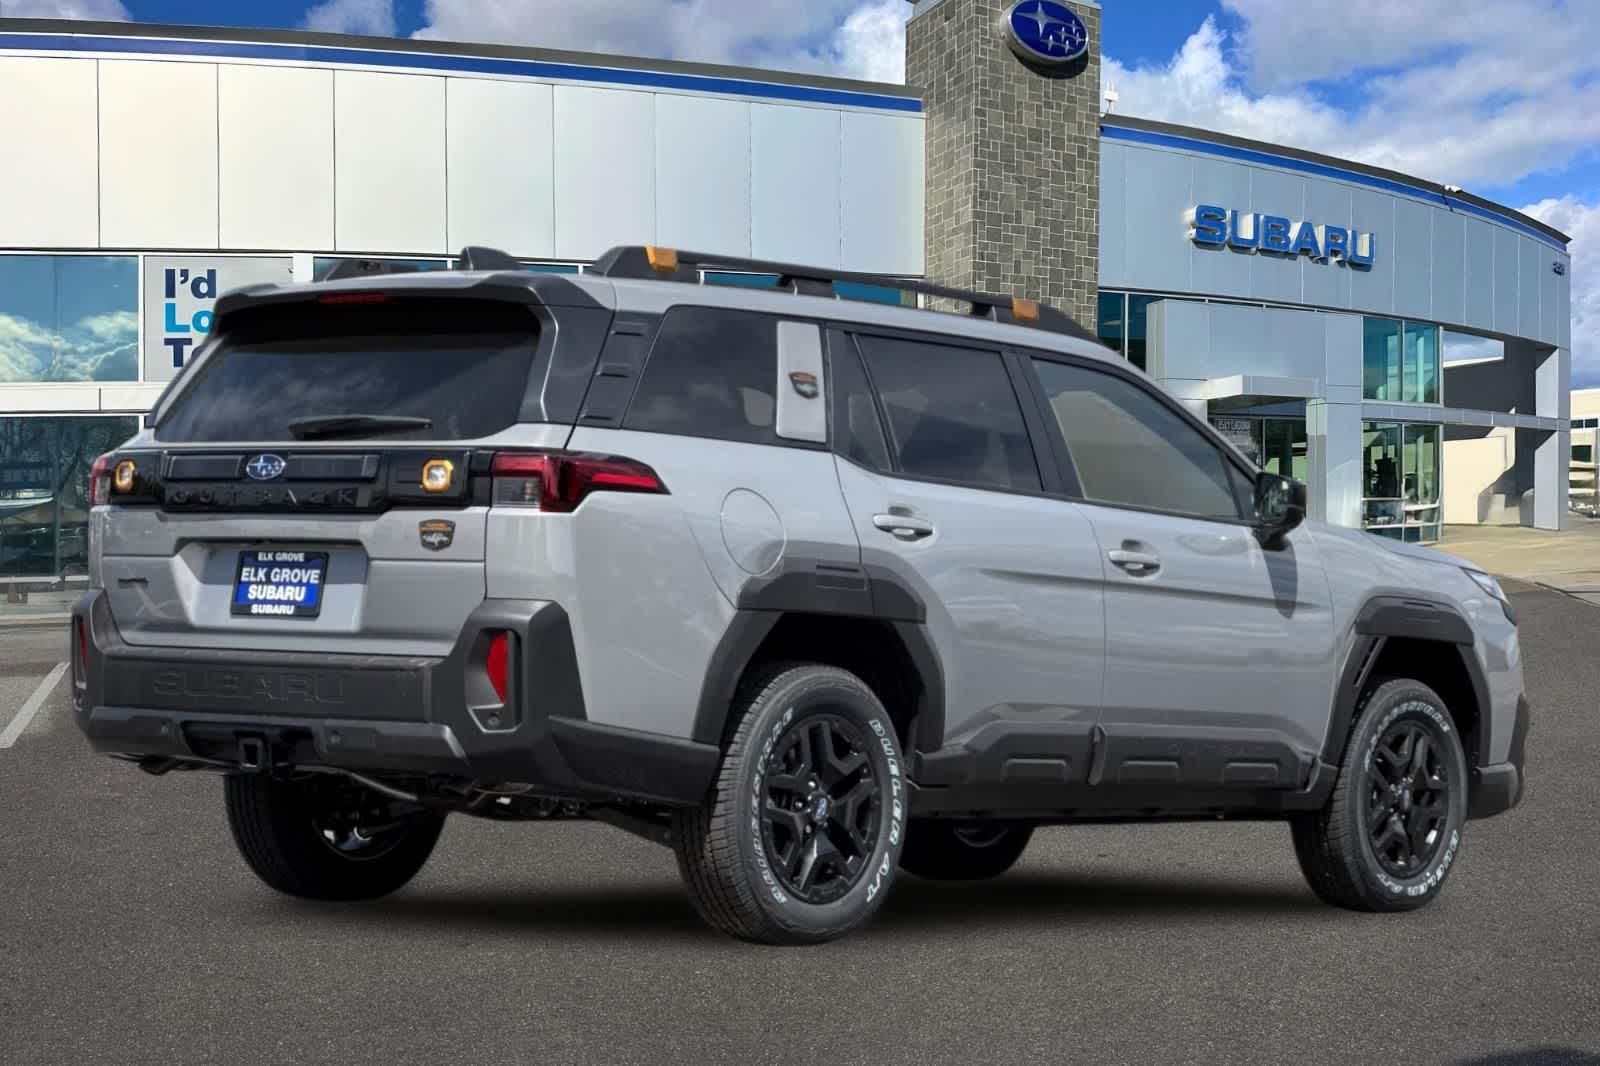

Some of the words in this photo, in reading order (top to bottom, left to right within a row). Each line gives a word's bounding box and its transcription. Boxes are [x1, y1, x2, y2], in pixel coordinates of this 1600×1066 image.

[1189, 204, 1377, 266] SUBARU
[164, 268, 217, 299] I’d
[163, 337, 203, 368] T
[257, 552, 274, 561] ELK
[275, 552, 305, 562] GROVE
[241, 567, 268, 582] ELK
[270, 568, 320, 584] GROVE
[247, 584, 307, 602] SUBARU
[250, 604, 295, 615] SUBARU
[152, 668, 347, 704] SUBARU
[866, 851, 890, 903] A/T
